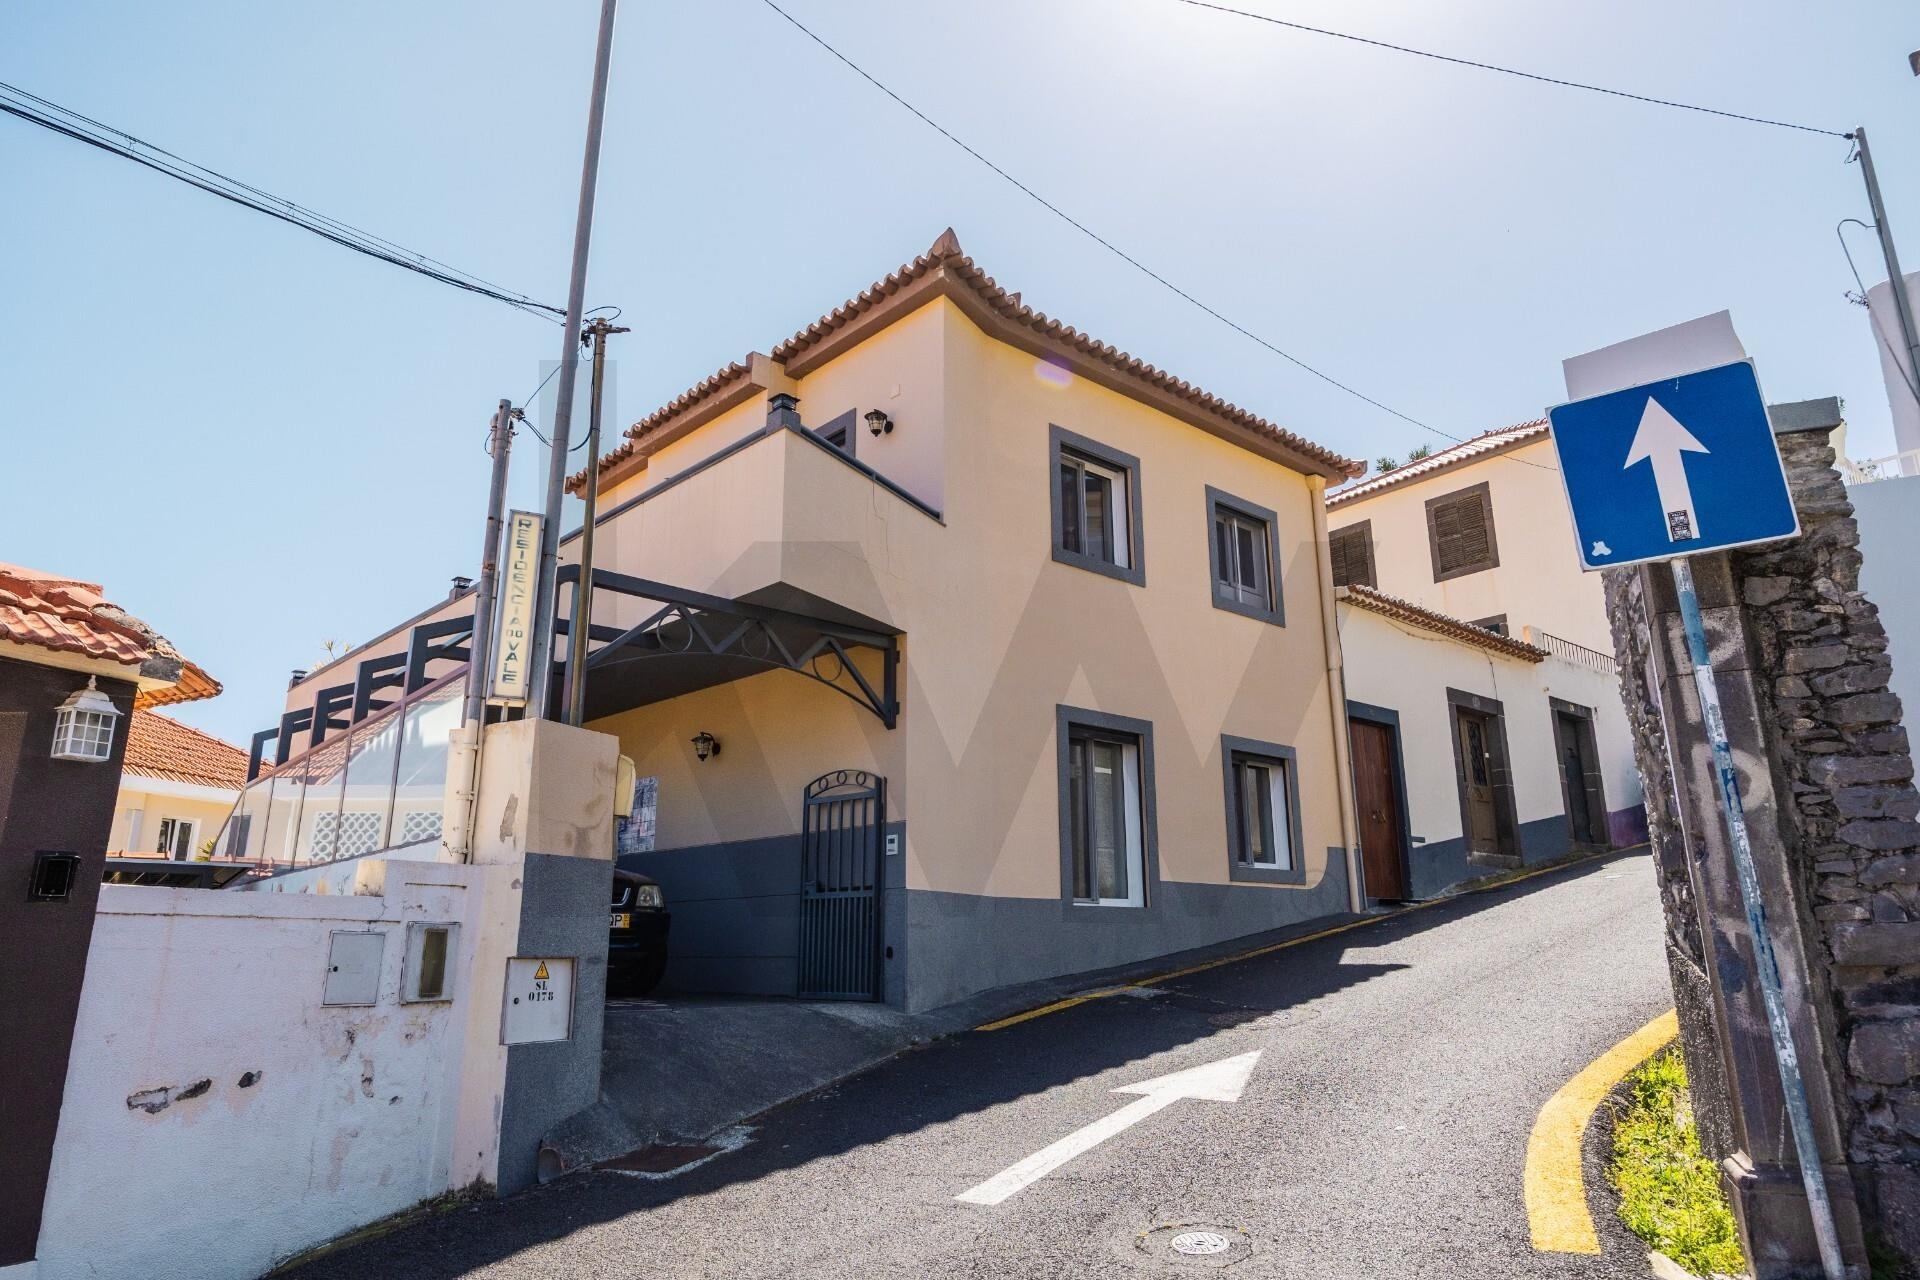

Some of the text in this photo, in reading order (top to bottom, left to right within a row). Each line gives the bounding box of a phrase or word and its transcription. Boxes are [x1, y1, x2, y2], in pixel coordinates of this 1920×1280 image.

[508, 518, 532, 626] RESIDENCIA
[502, 641, 519, 684] VALE
[528, 991, 554, 1002] 0178
[535, 981, 548, 991] SL
